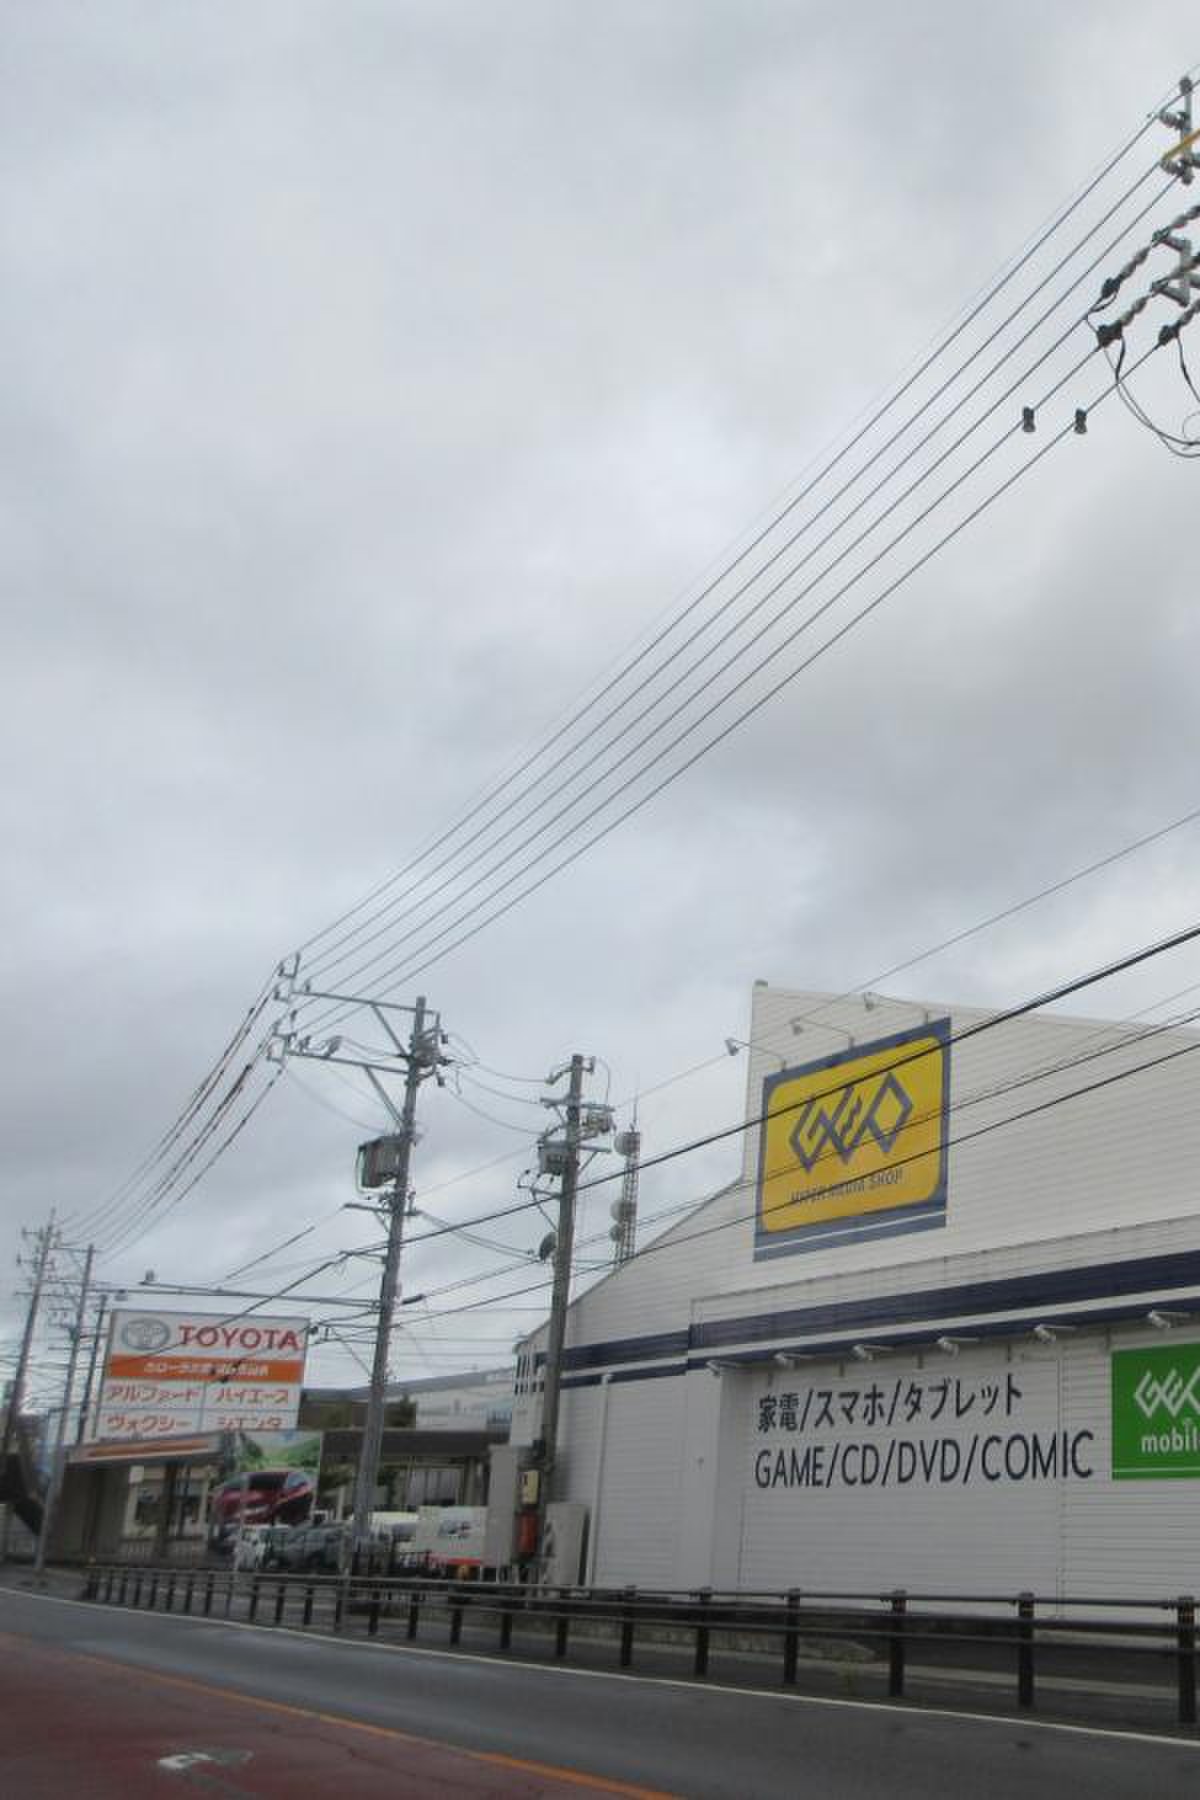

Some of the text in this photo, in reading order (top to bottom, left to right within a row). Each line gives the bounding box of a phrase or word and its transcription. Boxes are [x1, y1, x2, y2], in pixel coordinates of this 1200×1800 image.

[789, 1071, 914, 1174] GEO
[179, 1325, 300, 1350] TOYOTA
[109, 1384, 200, 1402] アルファード
[214, 1387, 289, 1404] ハイエース
[757, 1372, 1023, 1433] 家電/スマホ/タブレット
[107, 1413, 193, 1433] ヴォクシー
[754, 1429, 1095, 1489] GAME/CD/DVD/COMIC
